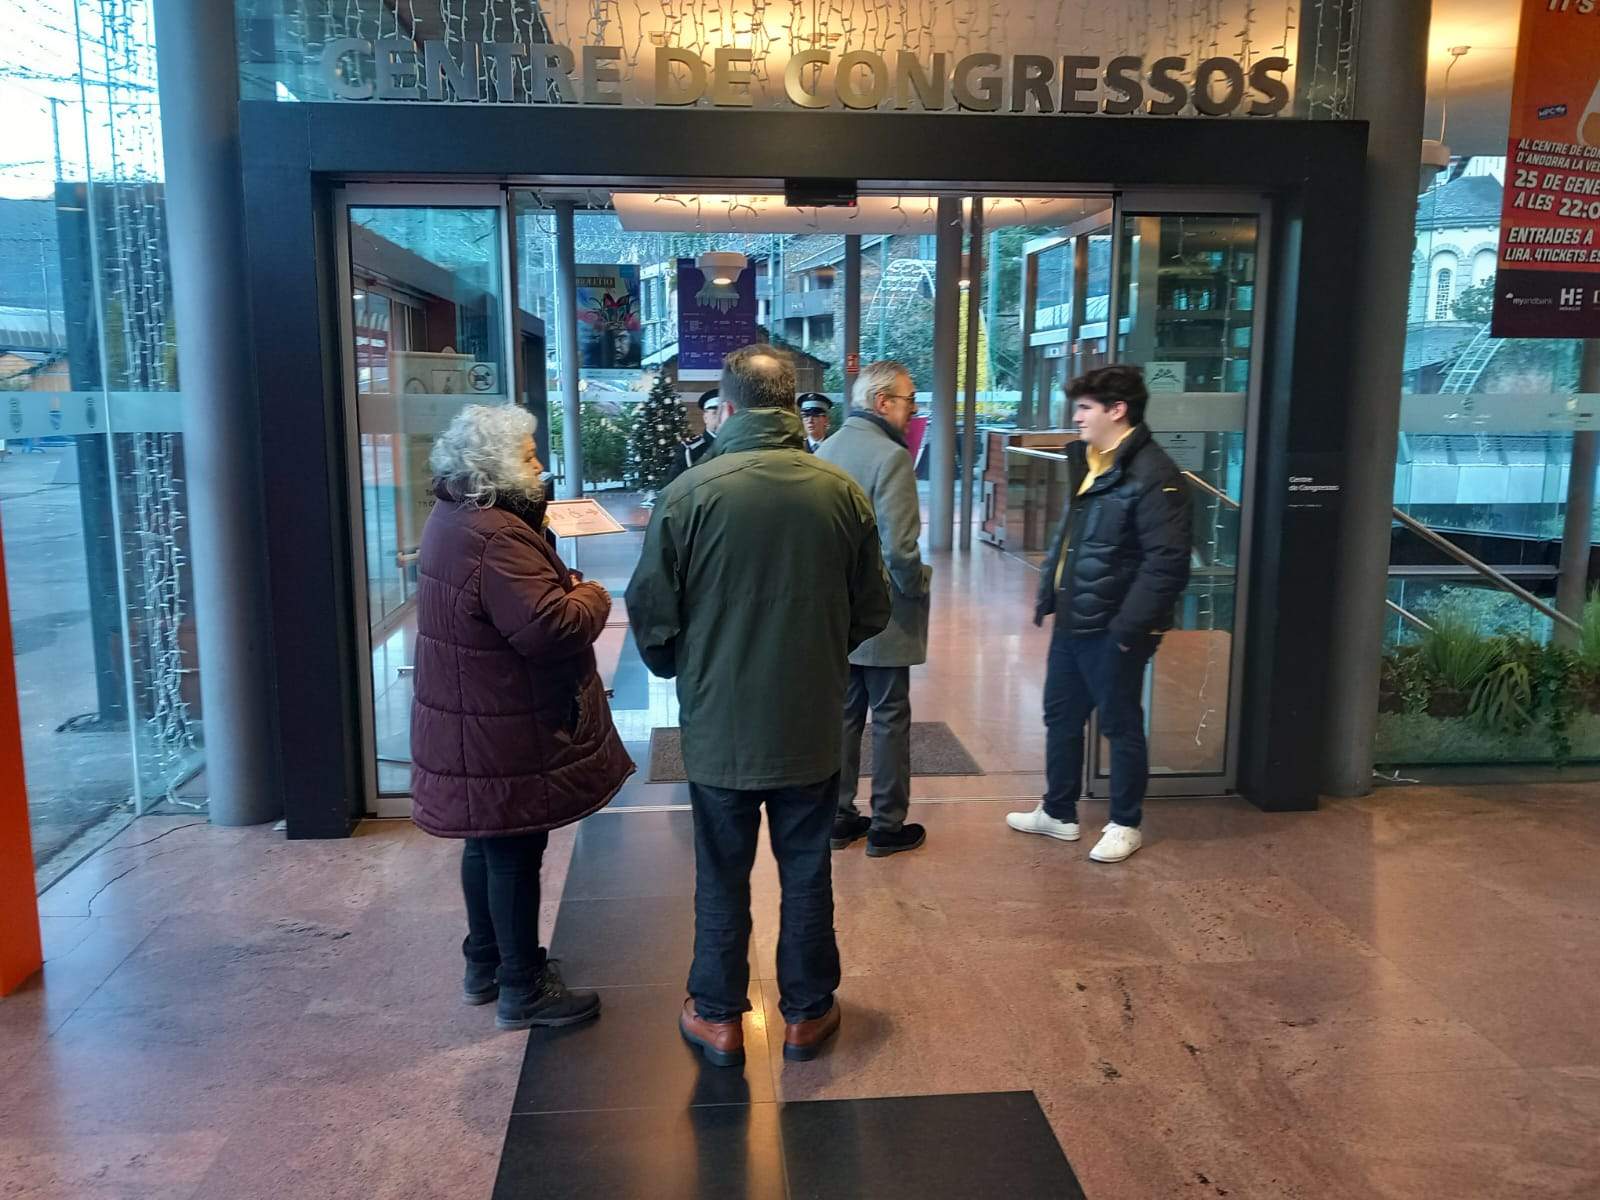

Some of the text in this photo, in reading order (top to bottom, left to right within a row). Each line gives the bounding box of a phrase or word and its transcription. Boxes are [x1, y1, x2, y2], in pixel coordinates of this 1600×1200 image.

[323, 40, 1290, 117] CENTRE DE CONGRESSOS
[1518, 138, 1530, 149] AL
[1532, 140, 1568, 154] CENTRE
[1569, 144, 1583, 156] DE
[1516, 151, 1570, 168] D'ANDORRA
[1571, 159, 1583, 170] LA
[1515, 169, 1600, 195] 25 DE GENE
[1514, 191, 1600, 219] A LES 22:0
[1508, 227, 1594, 245] ENTRADES A
